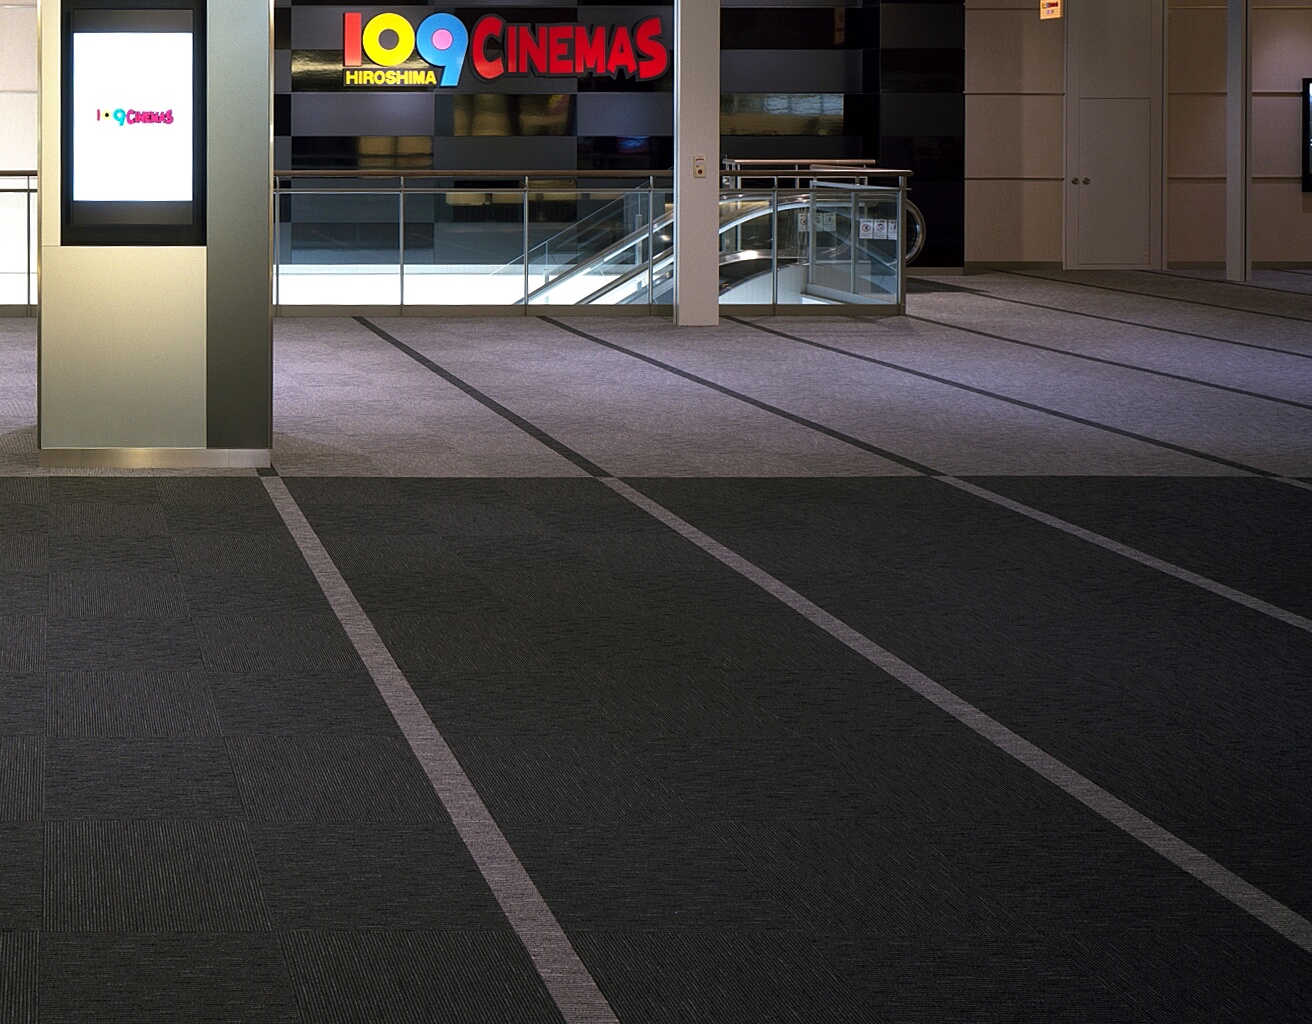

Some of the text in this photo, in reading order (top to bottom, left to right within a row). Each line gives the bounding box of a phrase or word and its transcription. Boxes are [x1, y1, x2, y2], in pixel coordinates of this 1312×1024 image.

[344, 12, 668, 86] 109 CINEMAS
[346, 70, 437, 85] HIROSHIMA
[127, 109, 174, 125] CINEMAS
